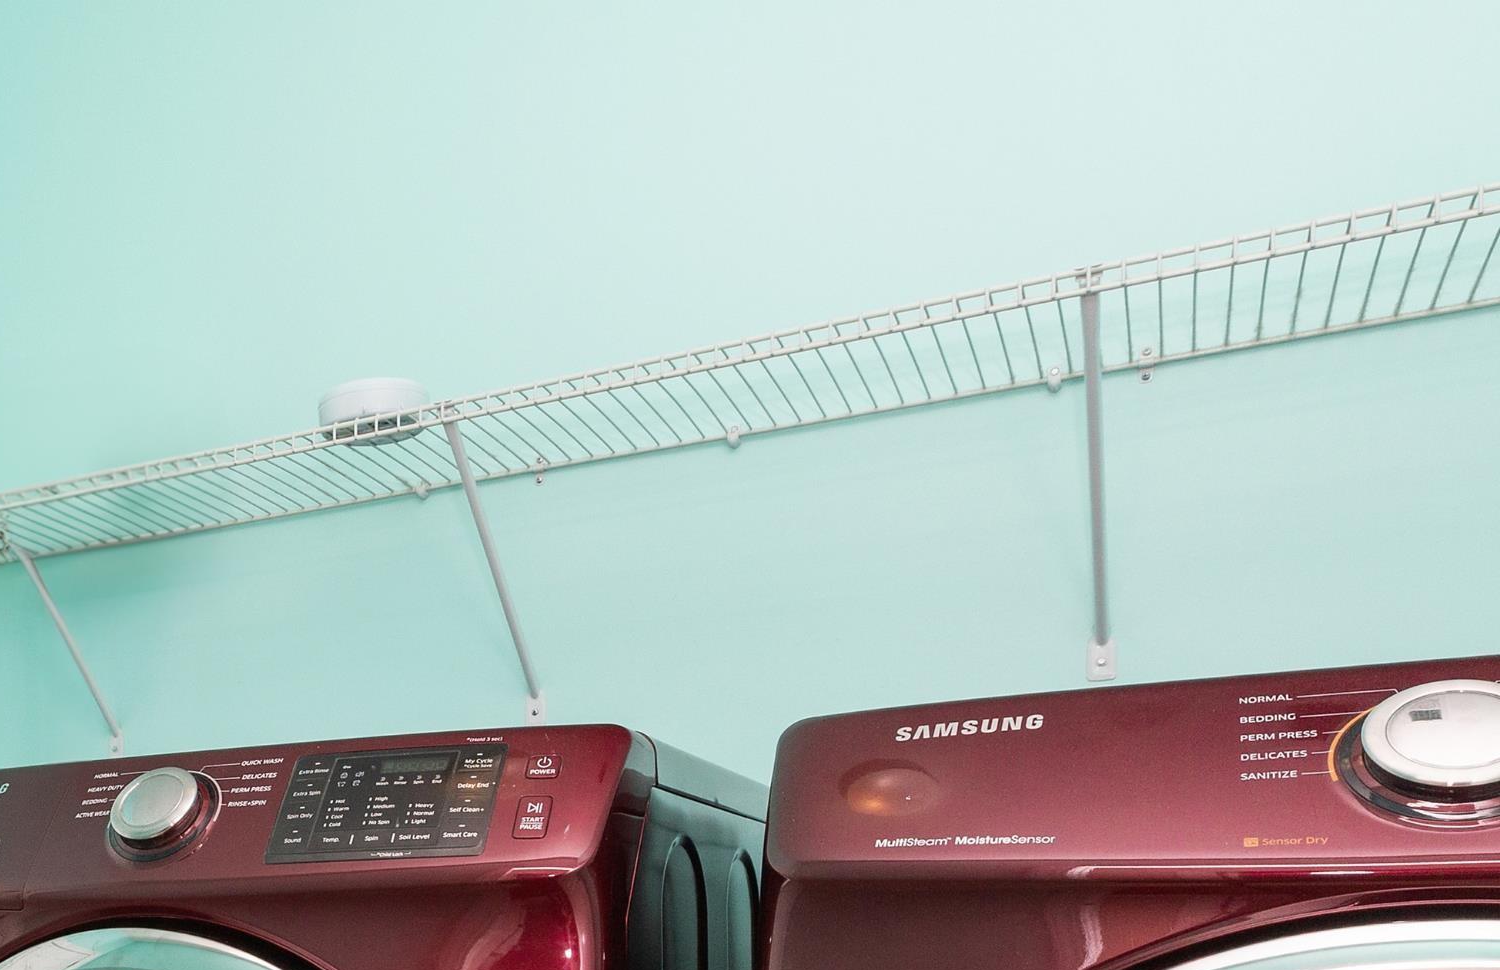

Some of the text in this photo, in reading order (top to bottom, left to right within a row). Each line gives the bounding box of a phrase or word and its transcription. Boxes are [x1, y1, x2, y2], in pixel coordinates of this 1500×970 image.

[1239, 694, 1293, 704] NORMAL
[1240, 713, 1296, 724] BEDDING
[895, 714, 1044, 742] SAMSUNG
[1240, 730, 1318, 742] PERM PRESS
[1240, 750, 1308, 761] DELICATES
[241, 772, 277, 780] DELICATES
[1240, 770, 1298, 781] SANITIZE
[87, 785, 107, 793] HEAVY
[81, 798, 108, 806] BEDDING
[75, 811, 94, 819] ACTIVE
[955, 834, 1055, 845] MoistureSensor
[1262, 836, 1328, 846] Sensor Dry
